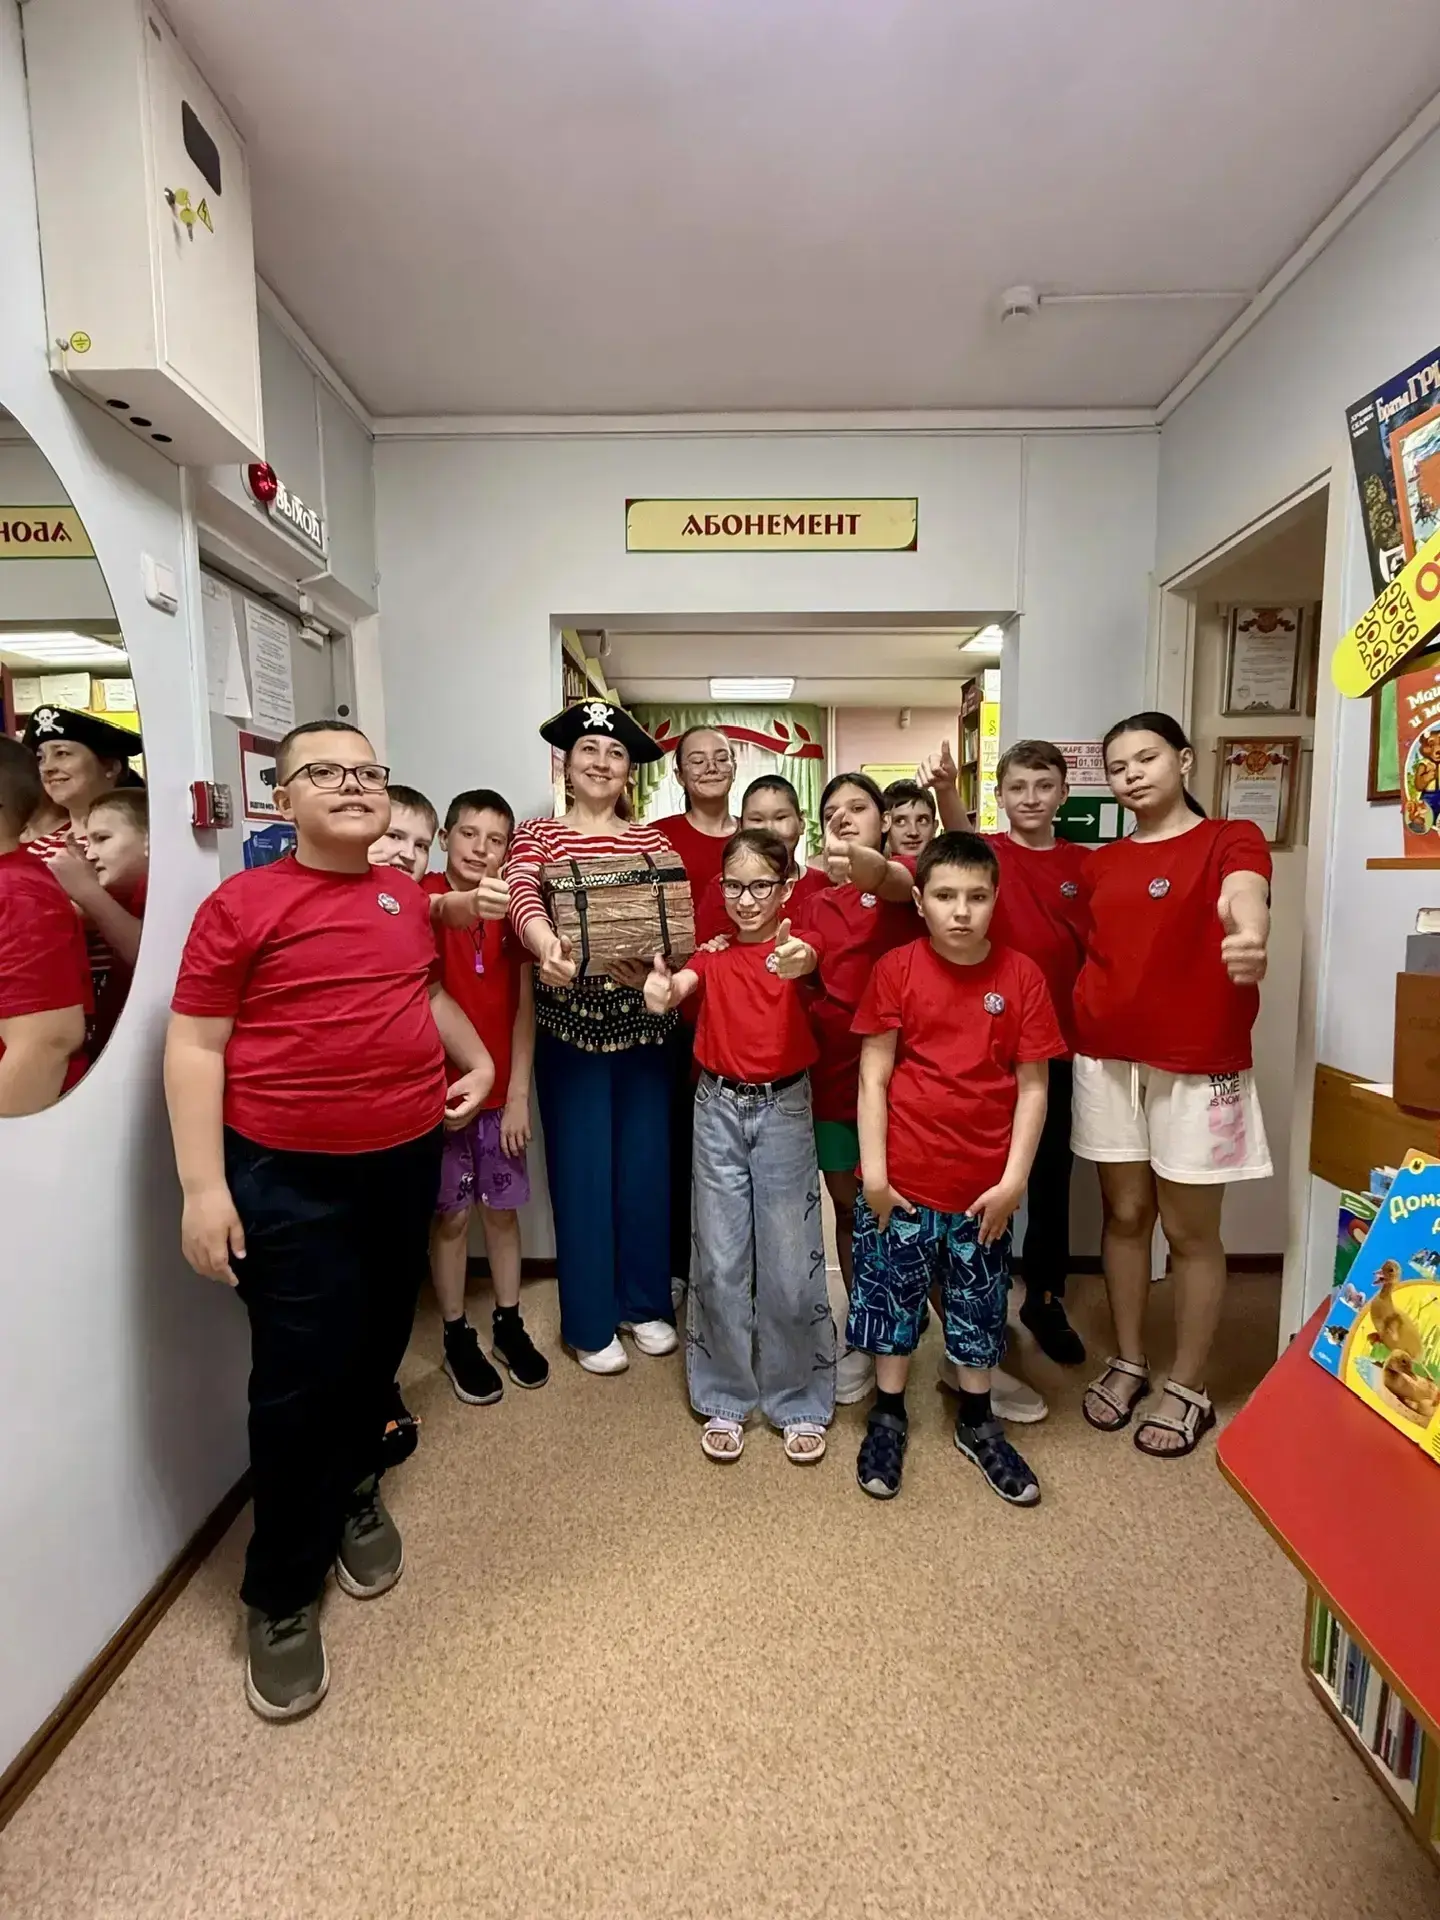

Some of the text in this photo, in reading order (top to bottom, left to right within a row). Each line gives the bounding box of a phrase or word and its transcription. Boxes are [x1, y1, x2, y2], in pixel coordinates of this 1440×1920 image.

[276, 479, 321, 546] ВЫХОД
[681, 514, 862, 536] АБОНЕМЕНТ
[1208, 1071, 1239, 1083] YOUR
[1209, 1080, 1240, 1096] TIME
[1210, 1094, 1240, 1106] IS NOW
